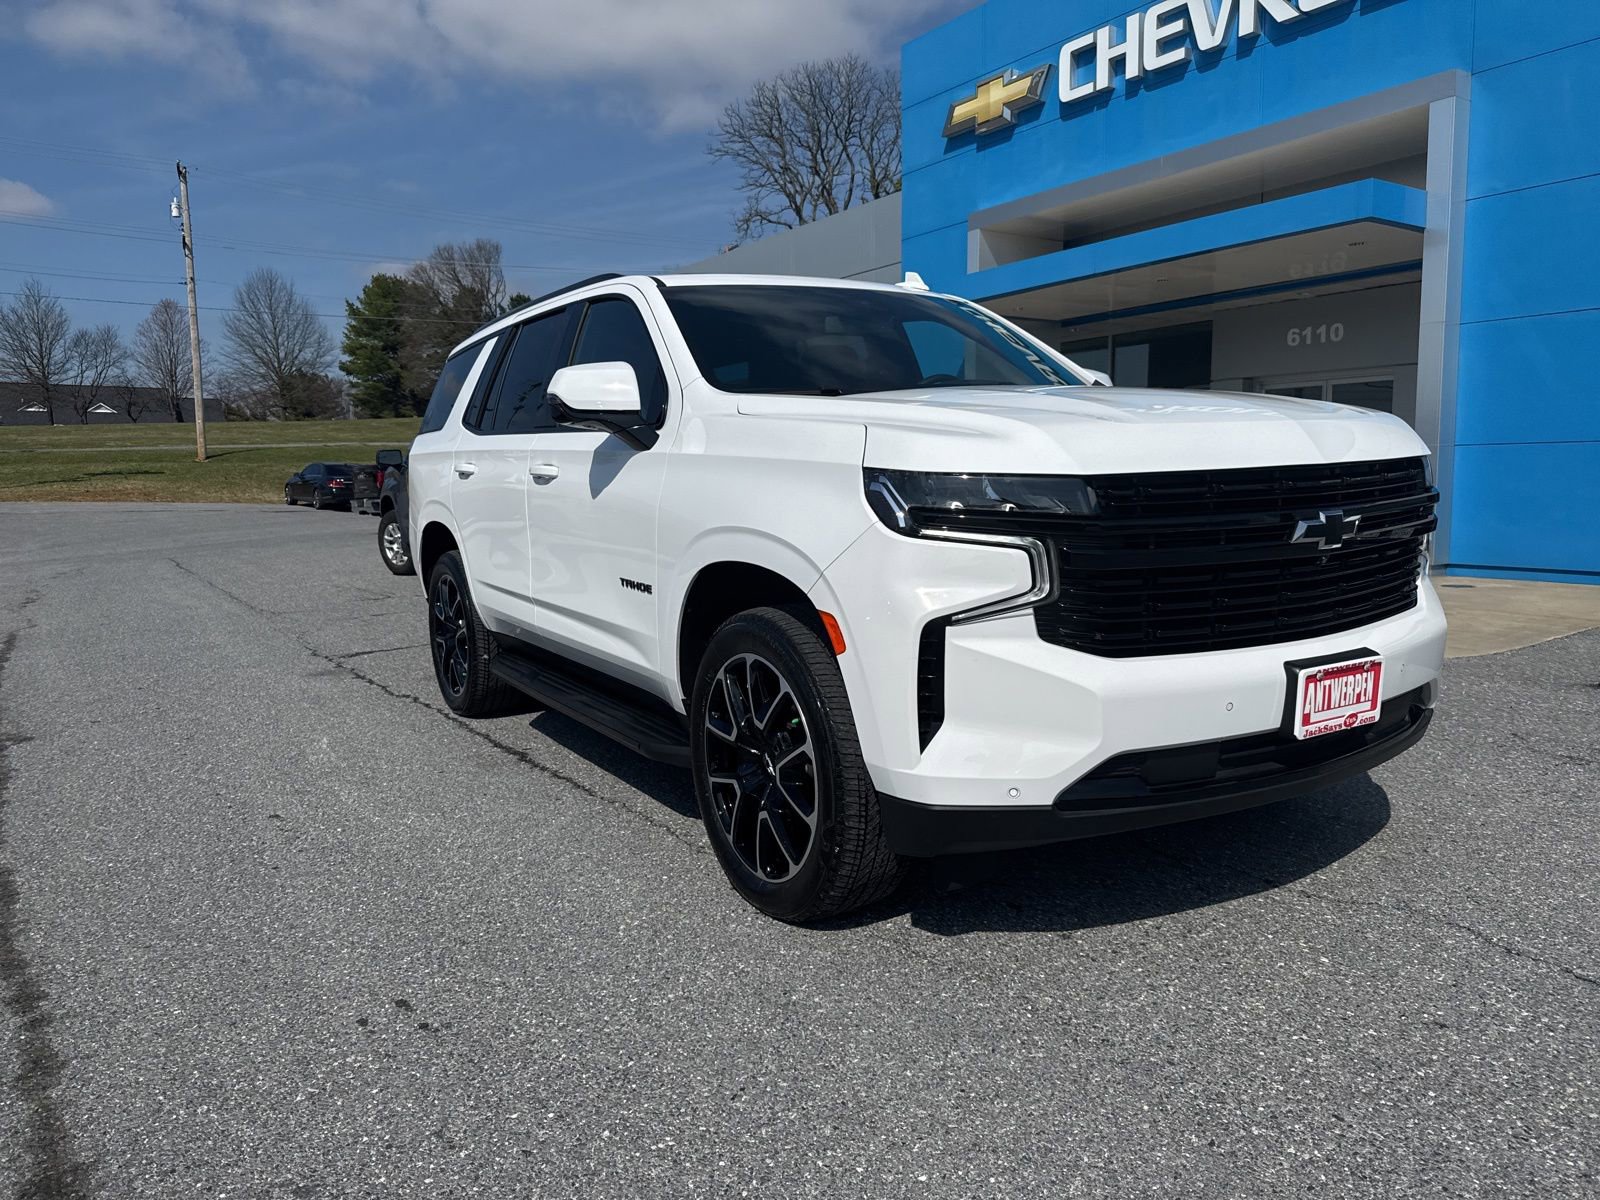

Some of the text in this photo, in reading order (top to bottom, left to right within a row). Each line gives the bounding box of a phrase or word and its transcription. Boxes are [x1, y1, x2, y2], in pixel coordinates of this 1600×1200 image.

[1058, 0, 1346, 103] CHEV
[1286, 322, 1344, 347] 6110
[619, 577, 653, 596] TAHOE
[1304, 670, 1375, 714] ANTWERPEN
